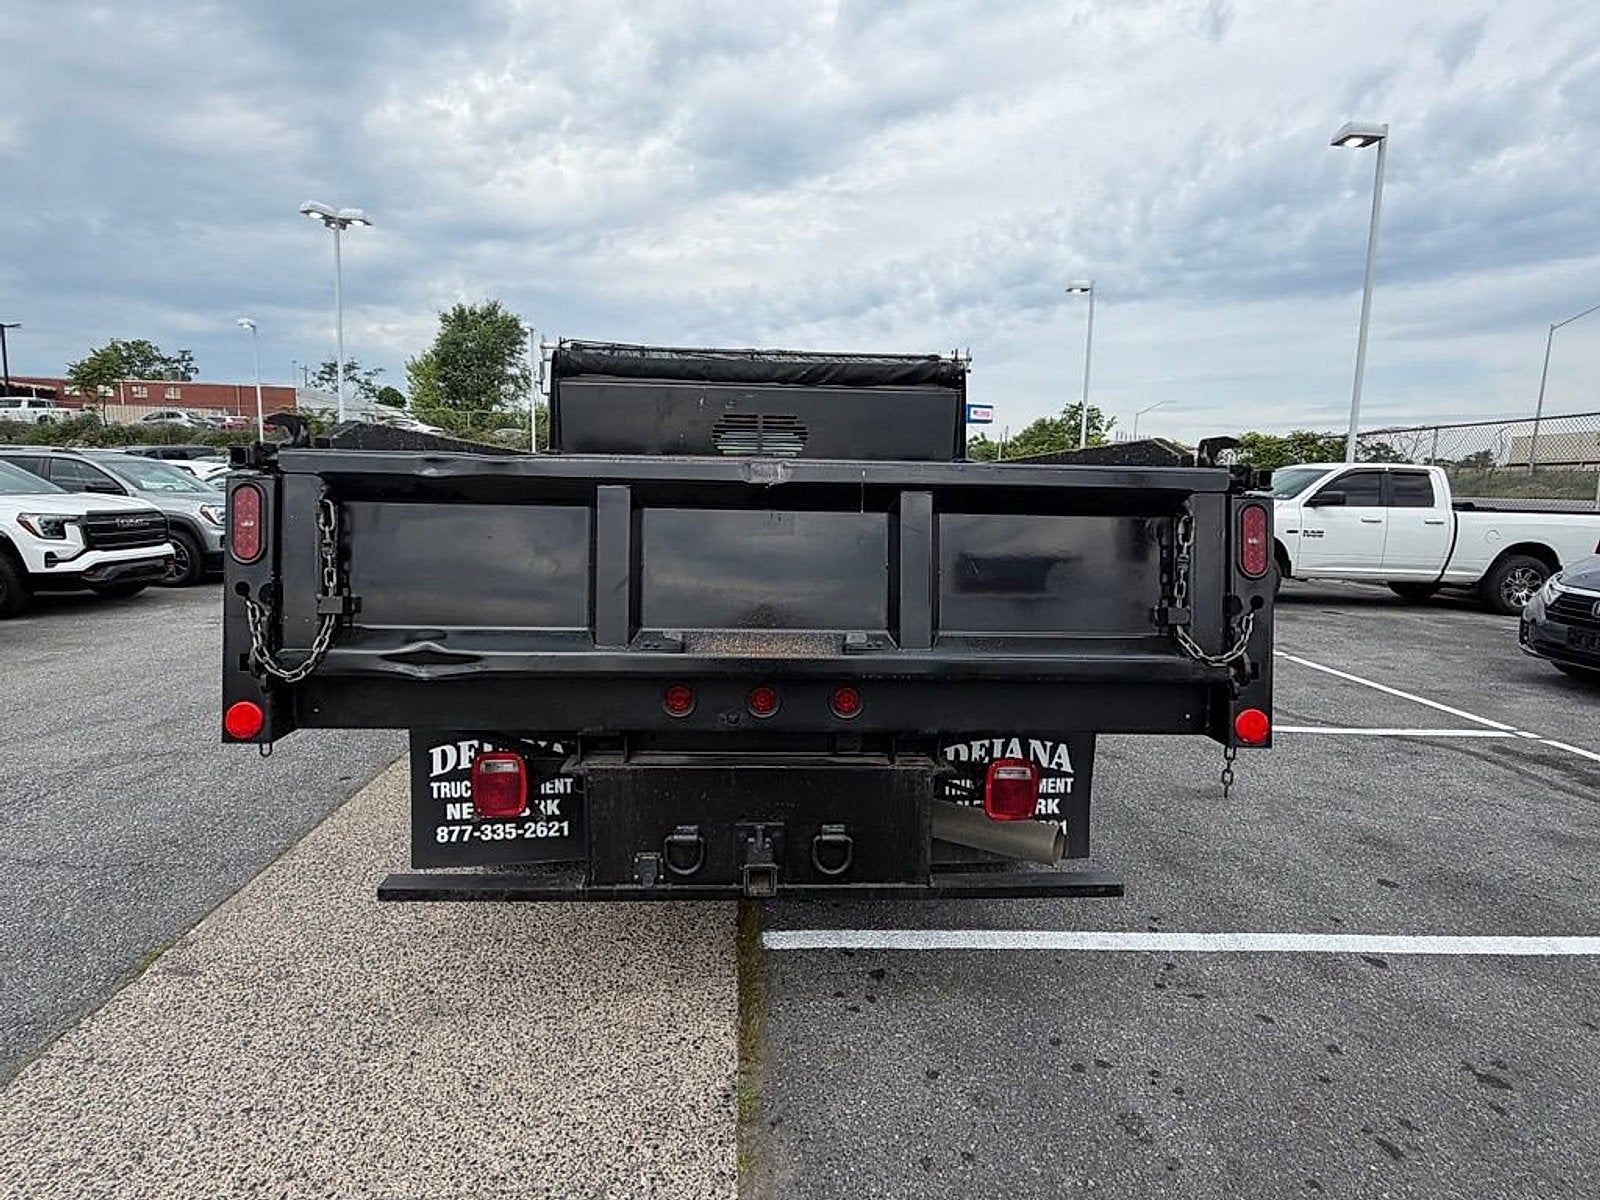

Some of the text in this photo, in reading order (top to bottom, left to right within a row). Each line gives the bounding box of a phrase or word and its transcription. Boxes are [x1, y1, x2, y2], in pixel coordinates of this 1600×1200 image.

[430, 781, 472, 799] TRUC
[446, 803, 474, 820] NE
[436, 821, 570, 843] 877-335-2621
